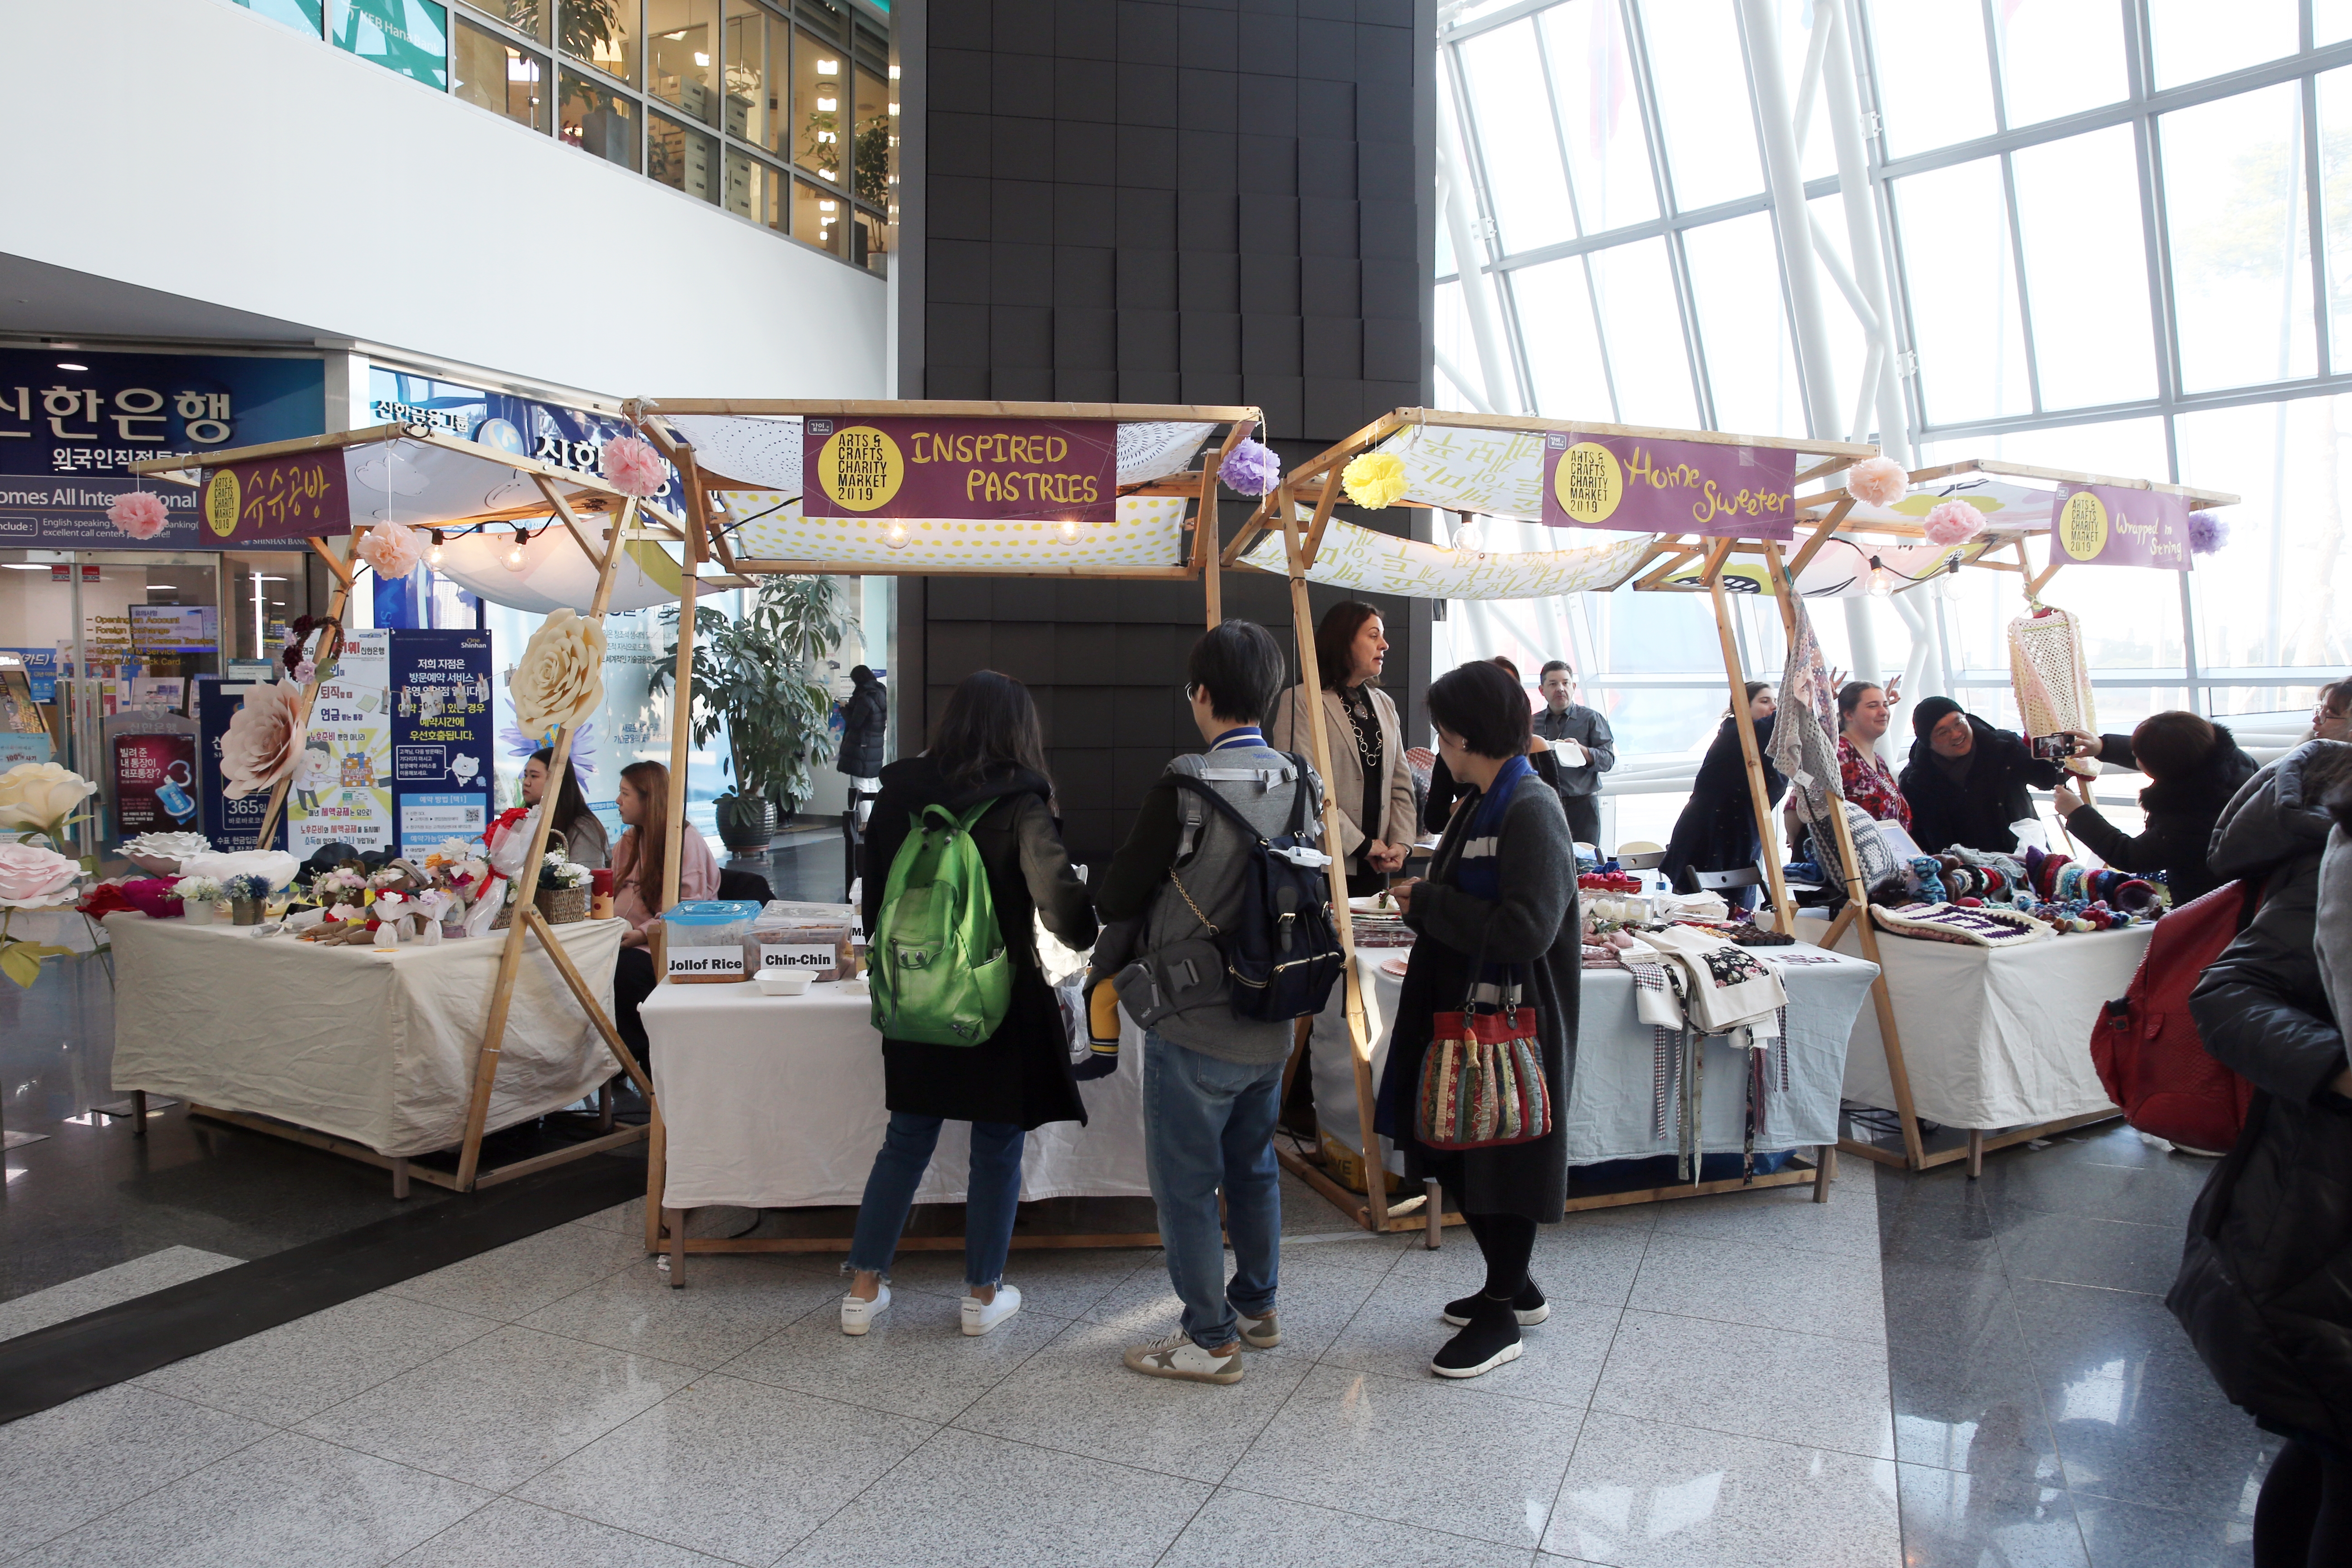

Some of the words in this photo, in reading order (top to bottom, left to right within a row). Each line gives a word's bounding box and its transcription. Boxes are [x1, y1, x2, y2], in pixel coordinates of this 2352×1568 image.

[360, 10, 382, 29] KEB
[385, 21, 412, 44] Hana
[414, 34, 440, 55] Bank
[377, 400, 469, 433] 신한금융그룹
[838, 434, 869, 447] ARTS
[873, 434, 881, 447] &
[838, 447, 883, 461] CRAFTS
[911, 432, 1068, 464] INSPIRED
[1571, 451, 1594, 464] ARTS
[1598, 452, 1603, 464] &
[537, 436, 671, 498] 신한
[838, 460, 887, 475] CHARITY
[1571, 463, 1605, 477] CRAFTS
[1623, 446, 1701, 490] Home
[215, 478, 228, 488] ARTS
[838, 474, 887, 488] MARKET
[966, 468, 1098, 504] PASTRIES
[1570, 475, 1608, 489] CHARITY
[52, 489, 75, 506] All
[81, 489, 197, 508] Inteional
[215, 487, 233, 498] CRAFTS
[838, 487, 873, 500] 2019
[1570, 487, 1608, 501] MARKET
[214, 497, 235, 509] CHARITY
[1570, 500, 1597, 513] 2019
[1693, 479, 1791, 523] Sweeter
[2072, 499, 2089, 510] ARTS
[2091, 500, 2095, 511] &
[215, 508, 235, 519] MARKET
[2072, 510, 2097, 521] CRAFTS
[43, 519, 72, 529] English
[74, 520, 110, 530] speaking
[215, 519, 230, 530] 2019
[2071, 520, 2098, 533] CHARITY
[2116, 512, 2160, 545] Wrapped
[2164, 524, 2173, 535] in
[2071, 530, 2098, 543] MARKET
[2071, 541, 2091, 552] 2019
[2150, 537, 2182, 563] String
[95, 616, 131, 625] Opening
[95, 626, 127, 635] Foreign
[130, 627, 170, 635] Exchange
[96, 637, 130, 645] Domestic
[361, 647, 385, 655] 신한은행
[418, 659, 436, 669] 저희
[438, 659, 466, 669] 지점은
[409, 672, 445, 683] 방문예약
[447, 672, 475, 683] 서비스
[321, 708, 340, 721] 연금
[467, 703, 485, 714] 경우
[420, 717, 465, 727] 예약시간에
[310, 731, 335, 741] 노후준비
[409, 730, 475, 741] 우선호출됩니다.
[120, 748, 137, 758] 빌려
[138, 748, 148, 758] 준
[121, 758, 129, 768] 내
[131, 758, 156, 768] 통장이
[121, 768, 161, 779] 대포통장?
[419, 795, 434, 804] 예약
[435, 795, 449, 804] 방법
[216, 836, 230, 844] 수표
[669, 959, 709, 971] Jollof
[712, 958, 743, 970] Rice
[765, 954, 831, 966] Chin-Chin
